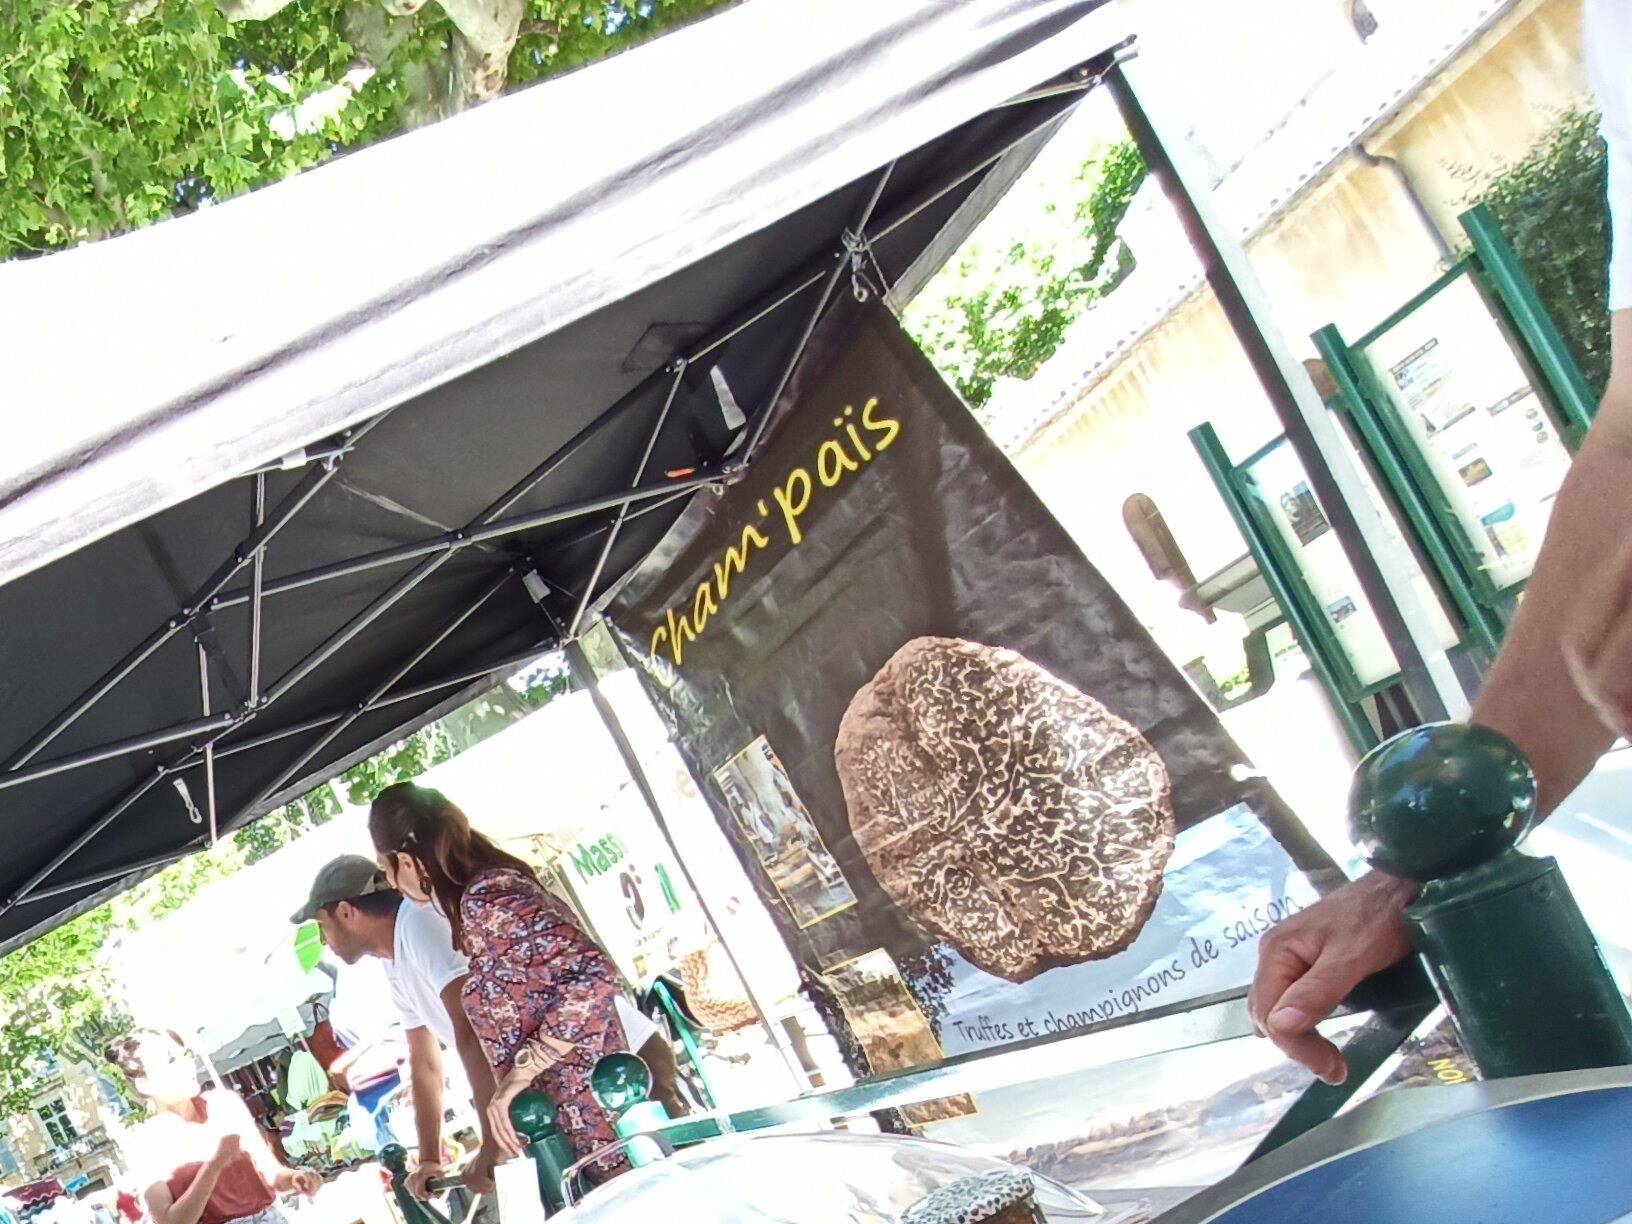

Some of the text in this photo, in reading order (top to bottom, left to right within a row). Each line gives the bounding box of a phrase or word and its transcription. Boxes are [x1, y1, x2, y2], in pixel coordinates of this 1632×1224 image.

[952, 895, 1304, 1043] Truffes et champignons de saison
